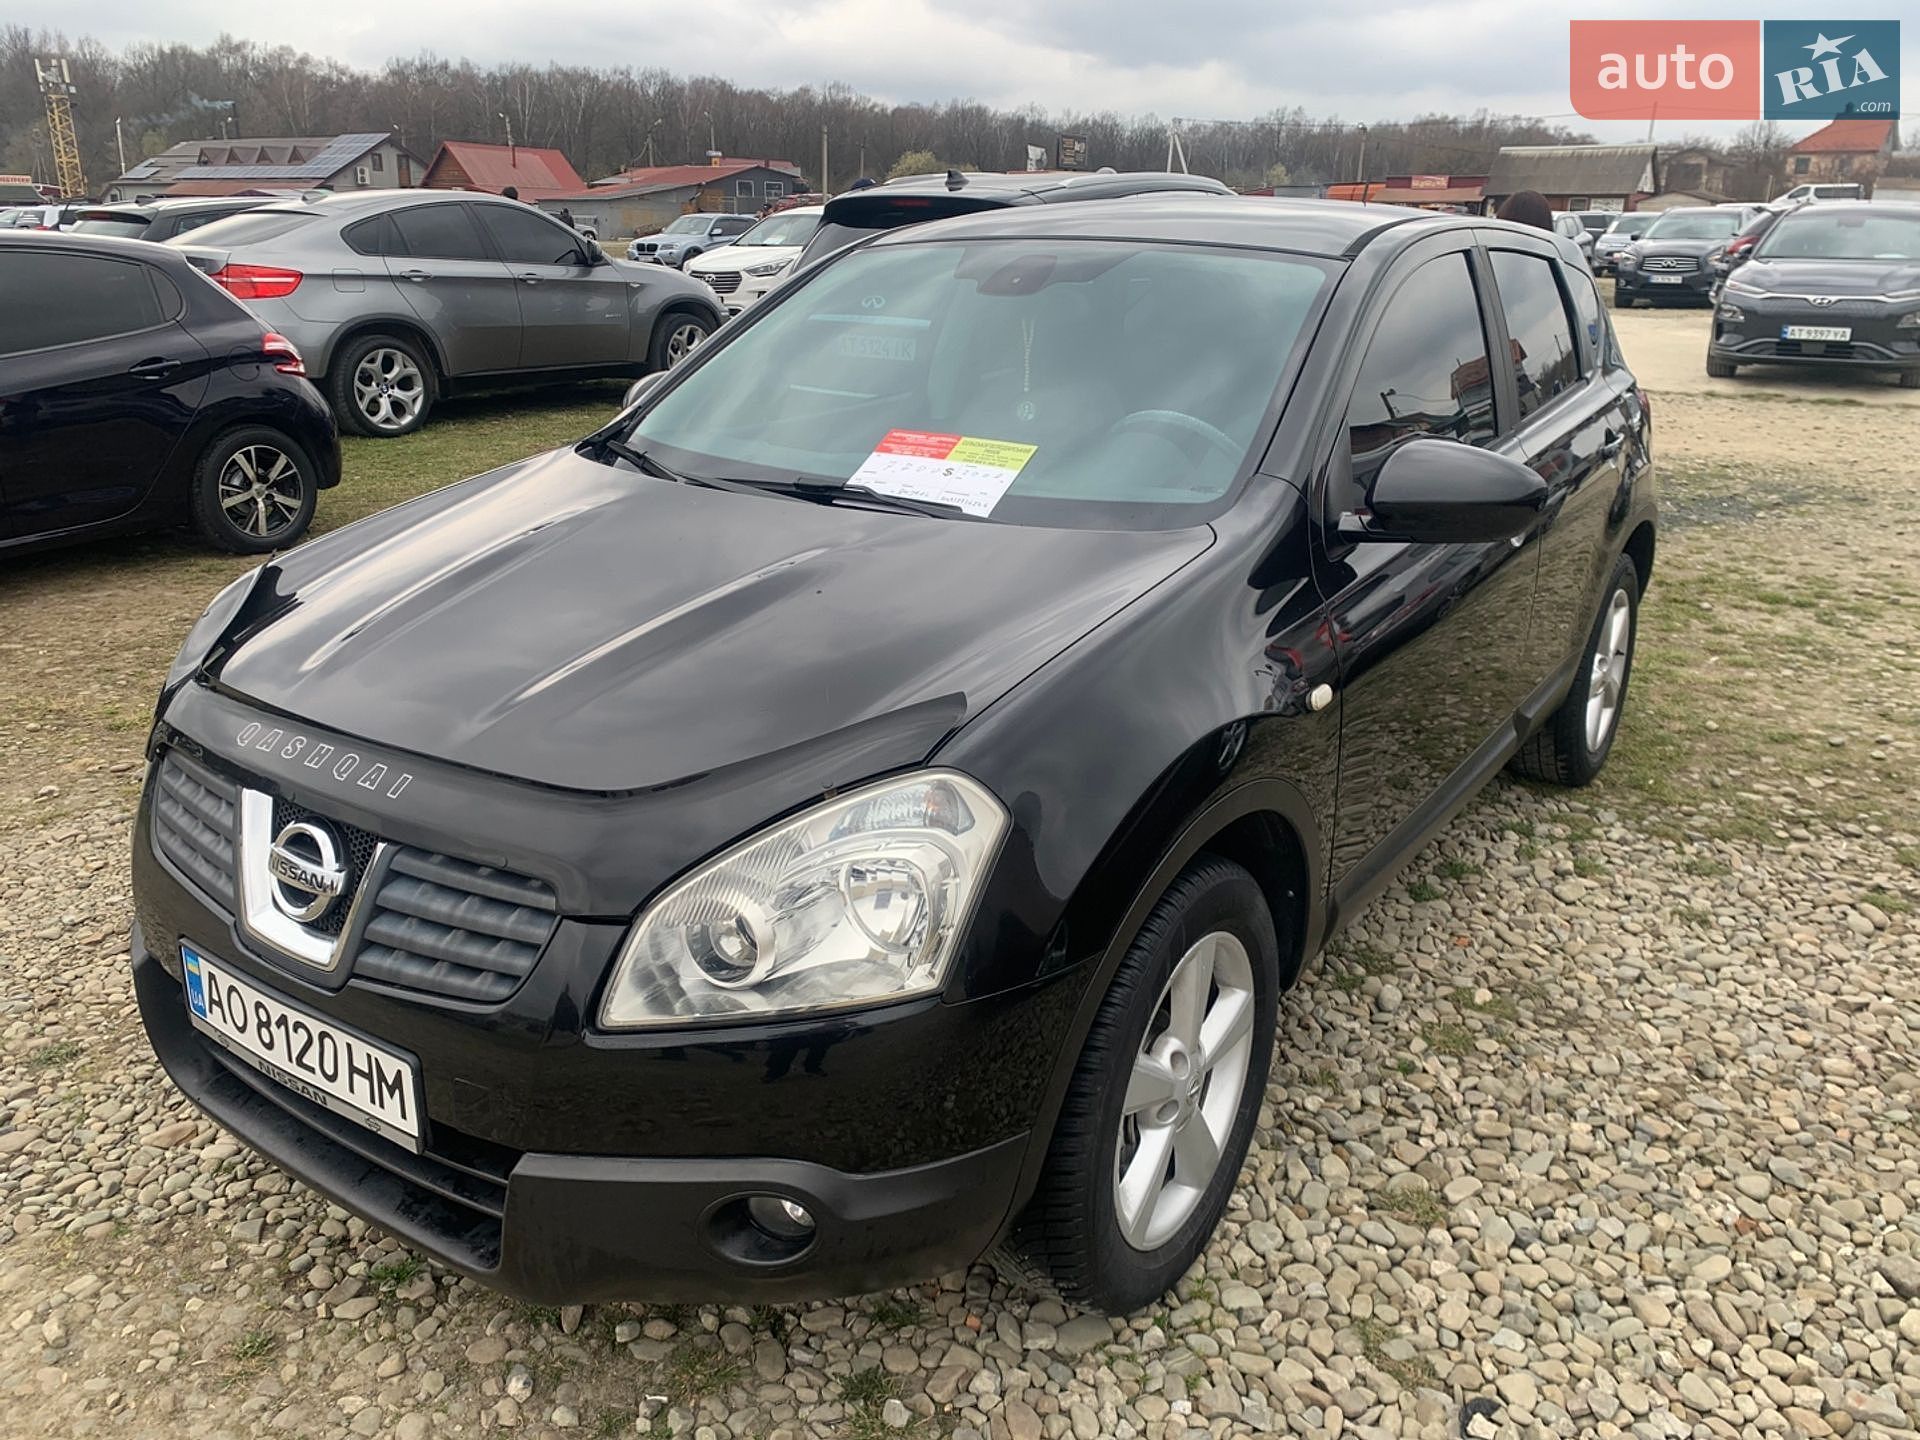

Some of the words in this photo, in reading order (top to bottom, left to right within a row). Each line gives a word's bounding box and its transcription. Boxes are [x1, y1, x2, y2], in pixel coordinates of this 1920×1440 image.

[1790, 328, 1805, 338] AT
[1806, 329, 1831, 339] 9397
[236, 722, 414, 799] QASHQAI
[270, 853, 324, 889] NISSAN
[192, 989, 205, 1008] UA
[207, 971, 248, 1034] AO
[254, 1000, 338, 1084] 8120
[346, 1042, 407, 1121] HM
[258, 1059, 328, 1106] NISSAN
